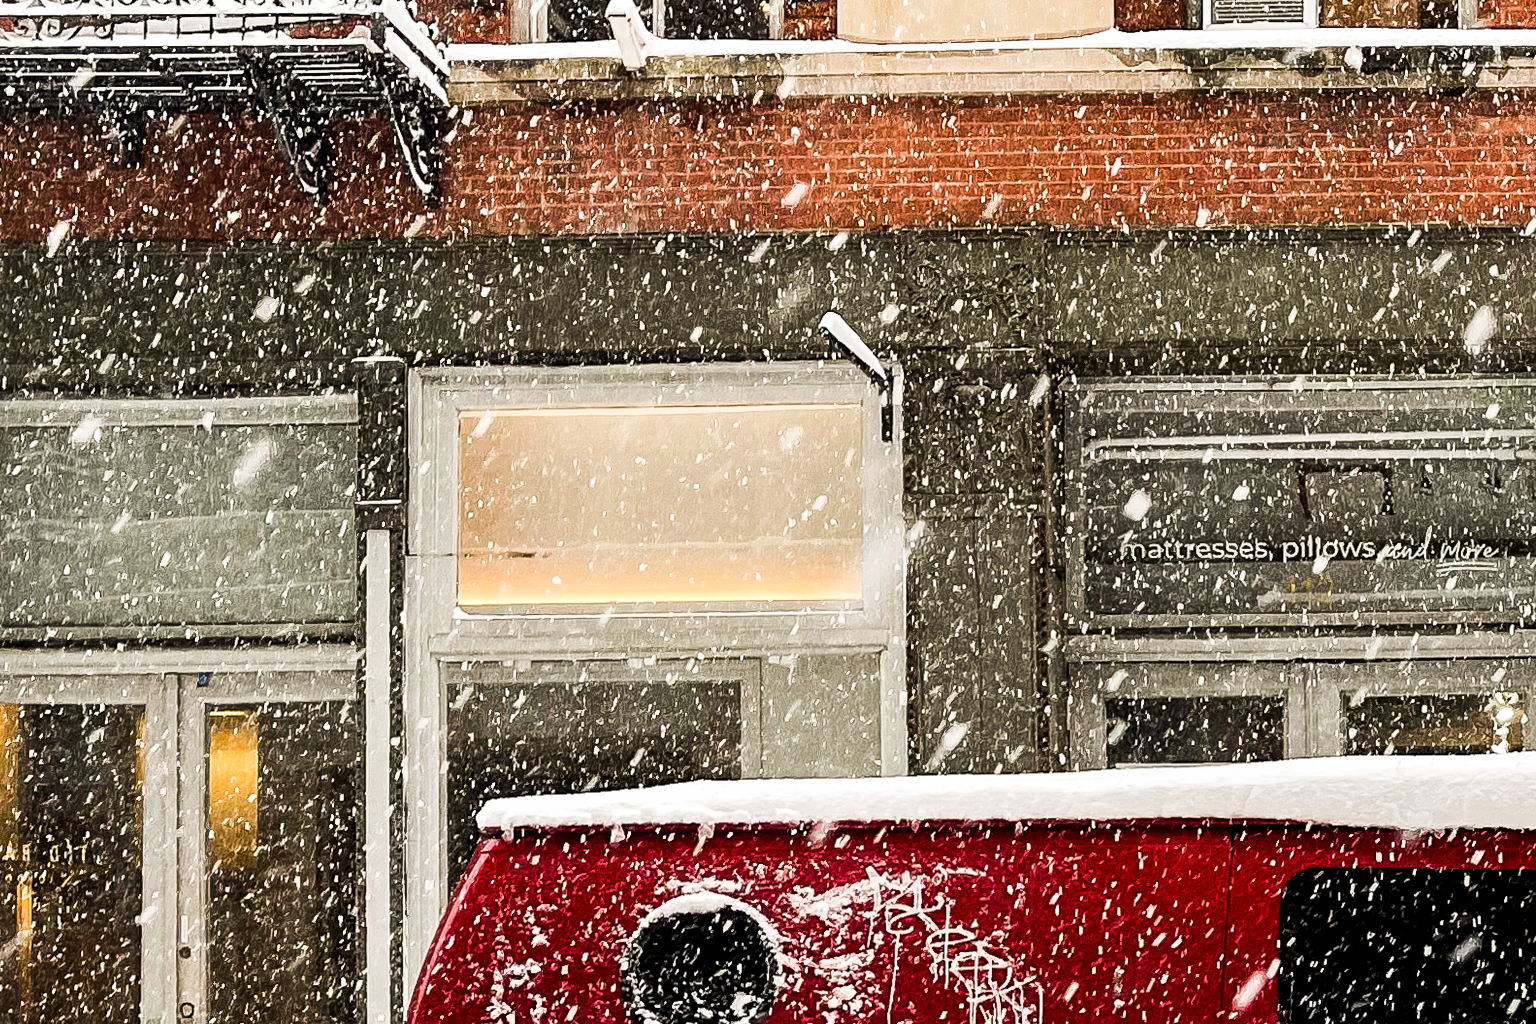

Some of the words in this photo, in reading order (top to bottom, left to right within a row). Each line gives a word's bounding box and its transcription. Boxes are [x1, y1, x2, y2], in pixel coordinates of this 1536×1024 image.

[1120, 538, 1274, 562] mattresses,
[1282, 534, 1376, 563] pillows
[1383, 525, 1433, 560] and
